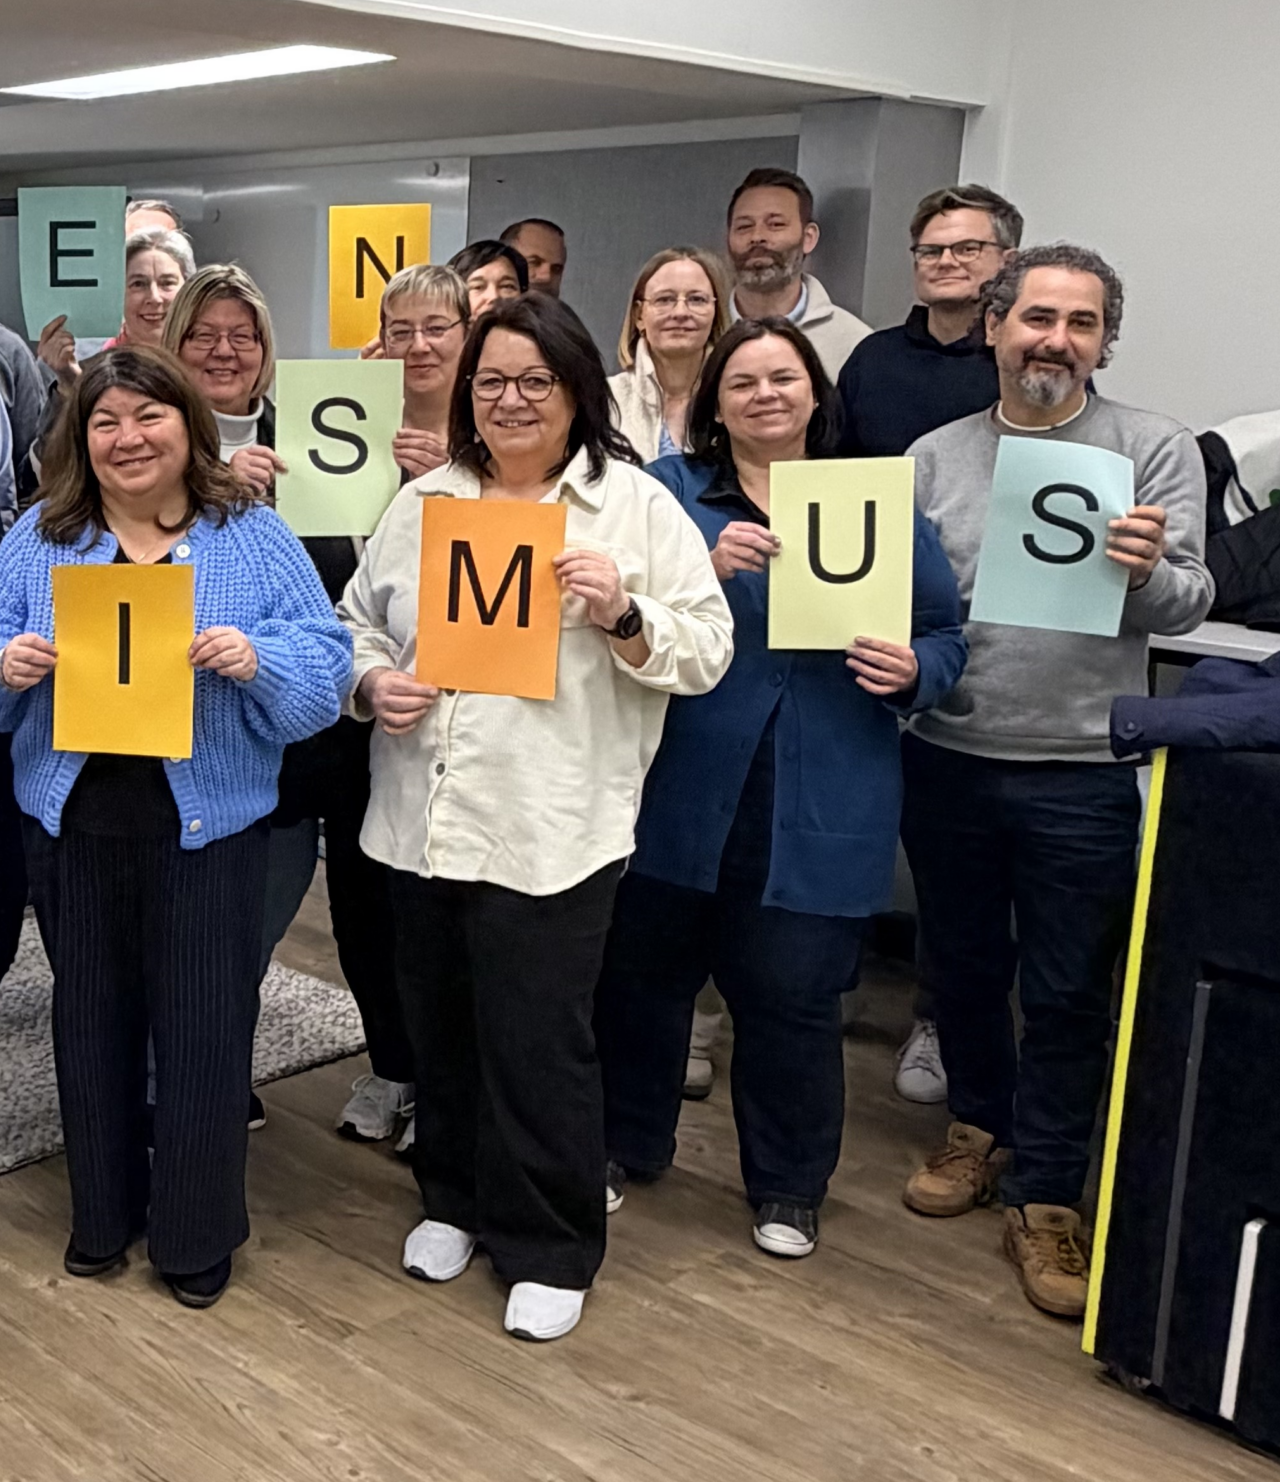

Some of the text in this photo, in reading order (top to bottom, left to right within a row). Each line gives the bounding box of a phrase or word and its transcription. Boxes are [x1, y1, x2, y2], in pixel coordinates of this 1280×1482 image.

[49, 220, 99, 288] E
[356, 236, 405, 298] N
[308, 396, 369, 475] S
[807, 500, 876, 585] U
[1022, 483, 1099, 565] S
[447, 539, 534, 628] M
[118, 601, 131, 685] I
